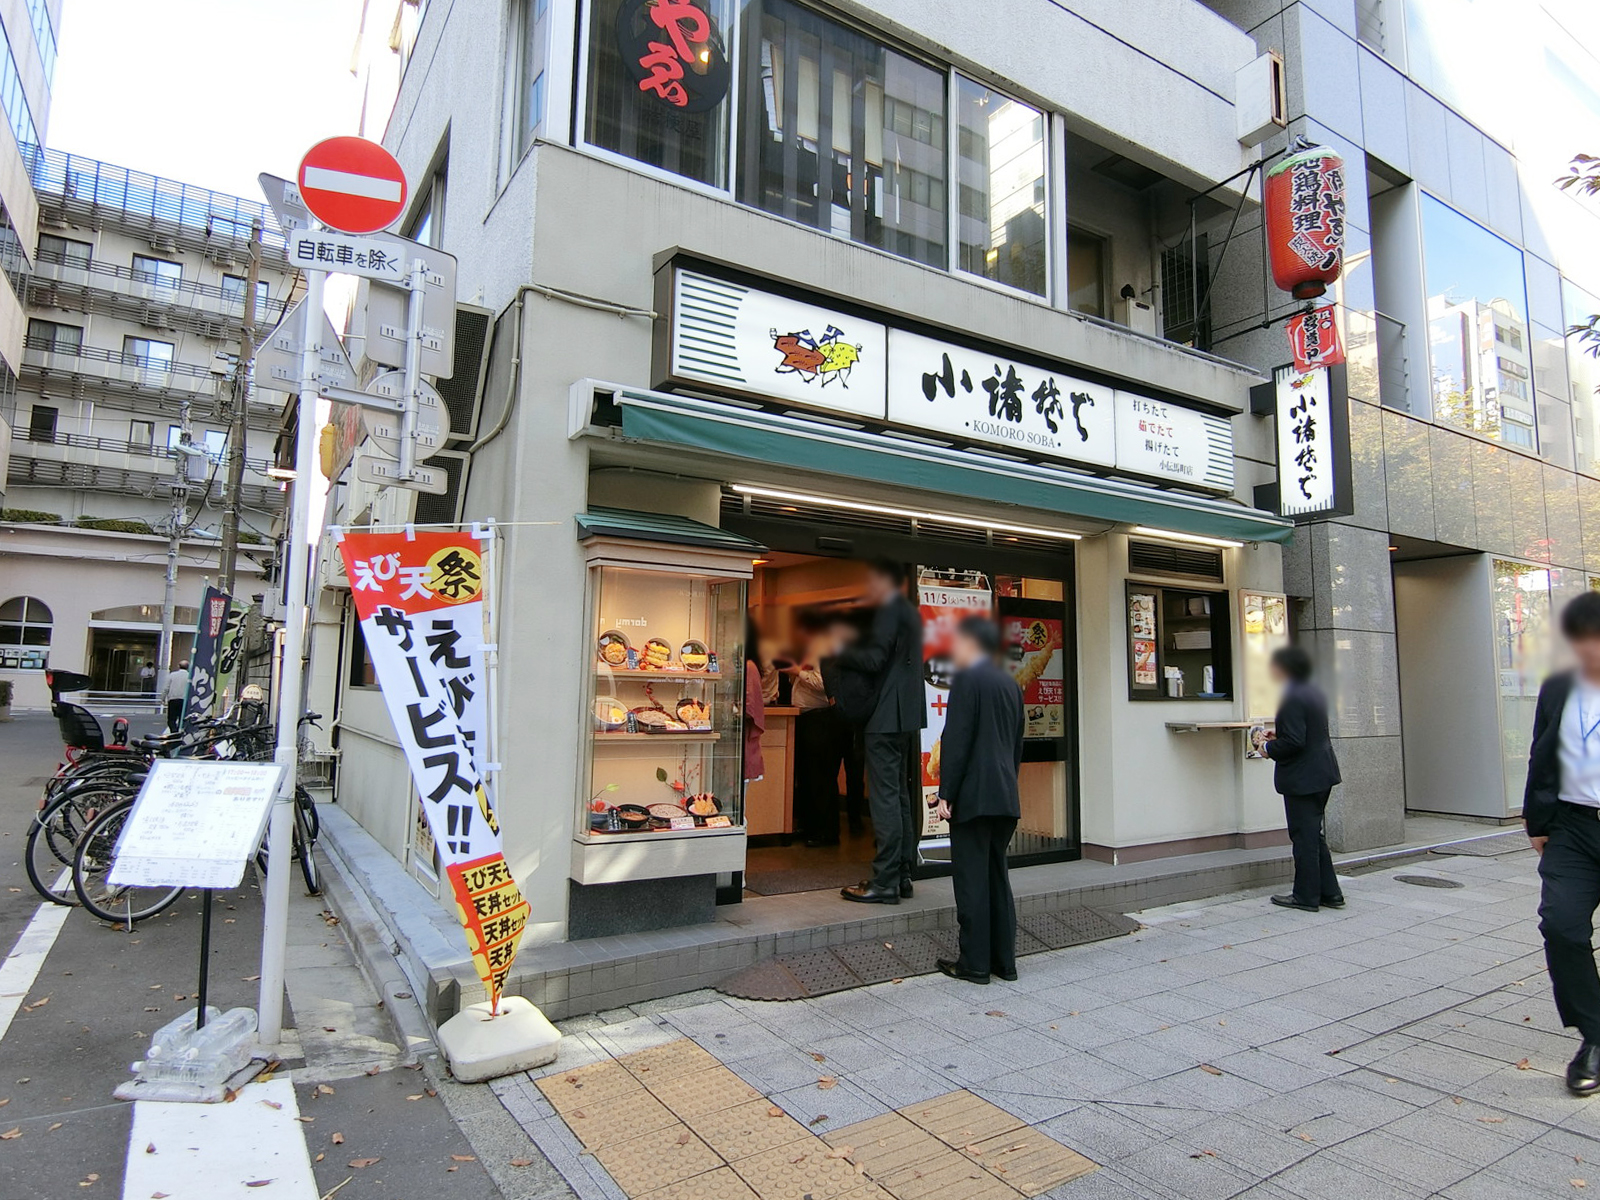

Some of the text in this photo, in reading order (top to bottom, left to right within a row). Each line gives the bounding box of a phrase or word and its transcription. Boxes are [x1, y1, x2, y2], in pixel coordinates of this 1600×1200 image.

[297, 239, 398, 271] 自転車を除く
[922, 352, 1095, 443] 小諸そば
[1133, 399, 1168, 419] 打ちたて
[973, 419, 1056, 449] KOMORO SOBA
[1139, 419, 1174, 438] 茹でたて
[1145, 439, 1180, 458] 揚げたて
[1289, 394, 1318, 500] 小諸そば
[1159, 459, 1194, 476] 小伝馬町店
[354, 550, 481, 601] えび天祭
[472, 888, 523, 917] 天丼セット
[483, 912, 527, 946] 天丼セット
